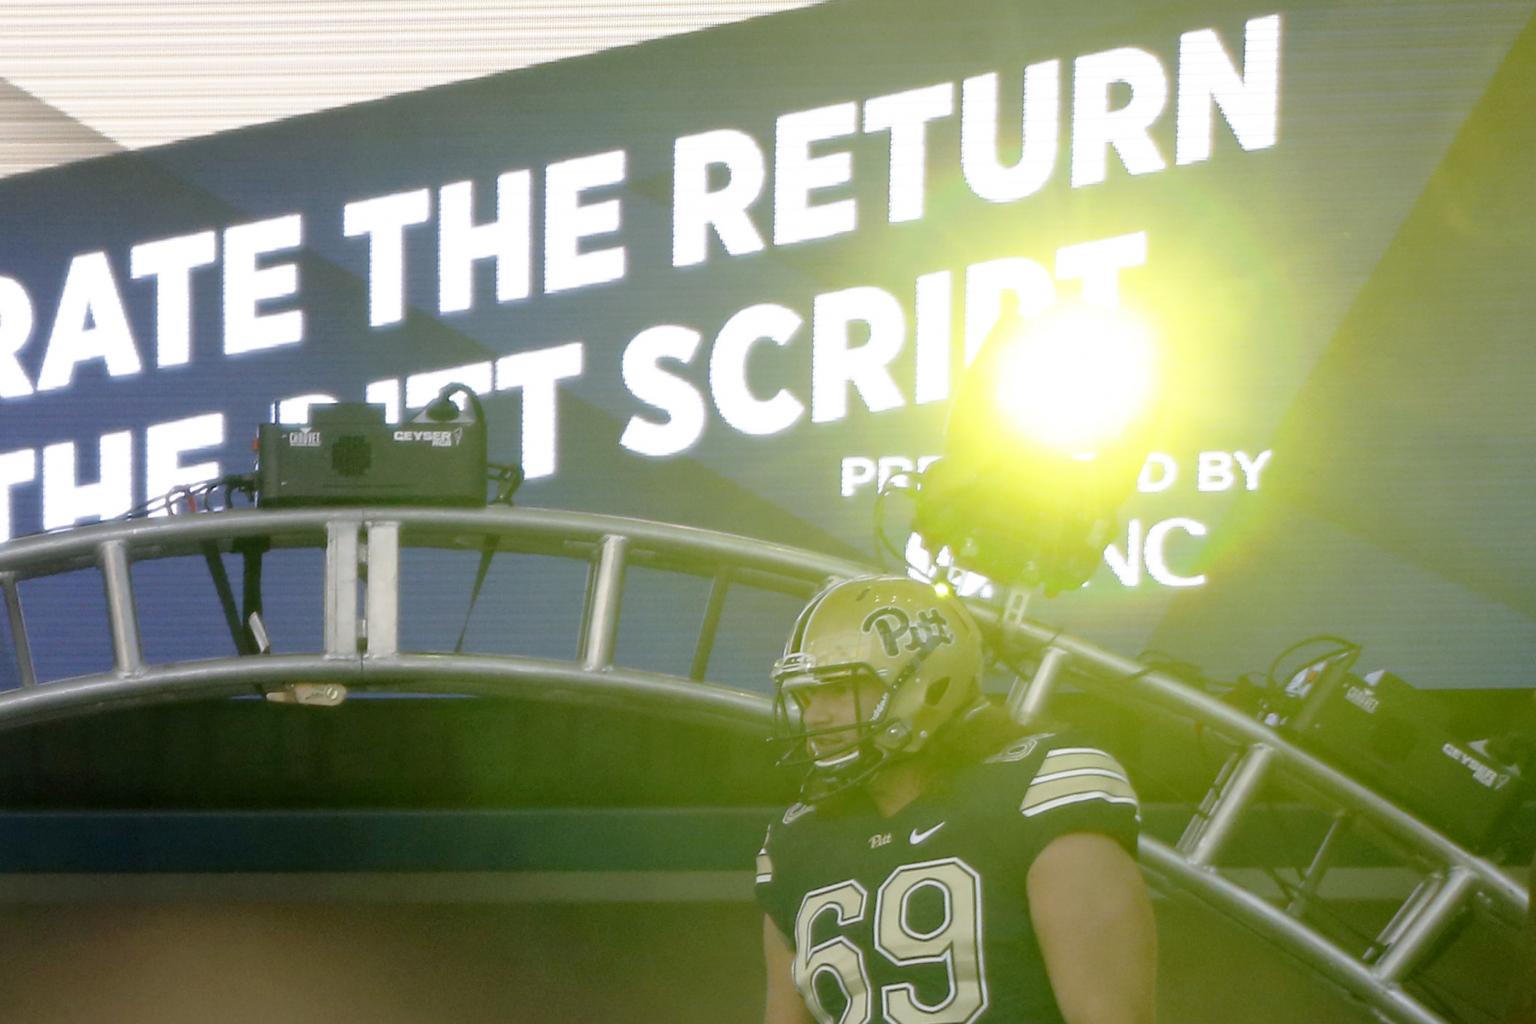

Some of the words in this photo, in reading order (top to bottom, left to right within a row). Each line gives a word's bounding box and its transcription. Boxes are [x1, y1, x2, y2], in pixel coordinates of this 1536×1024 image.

[343, 149, 627, 329] THE
[671, 14, 1280, 269] RETURN
[620, 231, 1146, 457] SCRIPT
[393, 431, 452, 441] GEYSER
[1197, 449, 1272, 492] BY
[863, 606, 954, 658] Pitt
